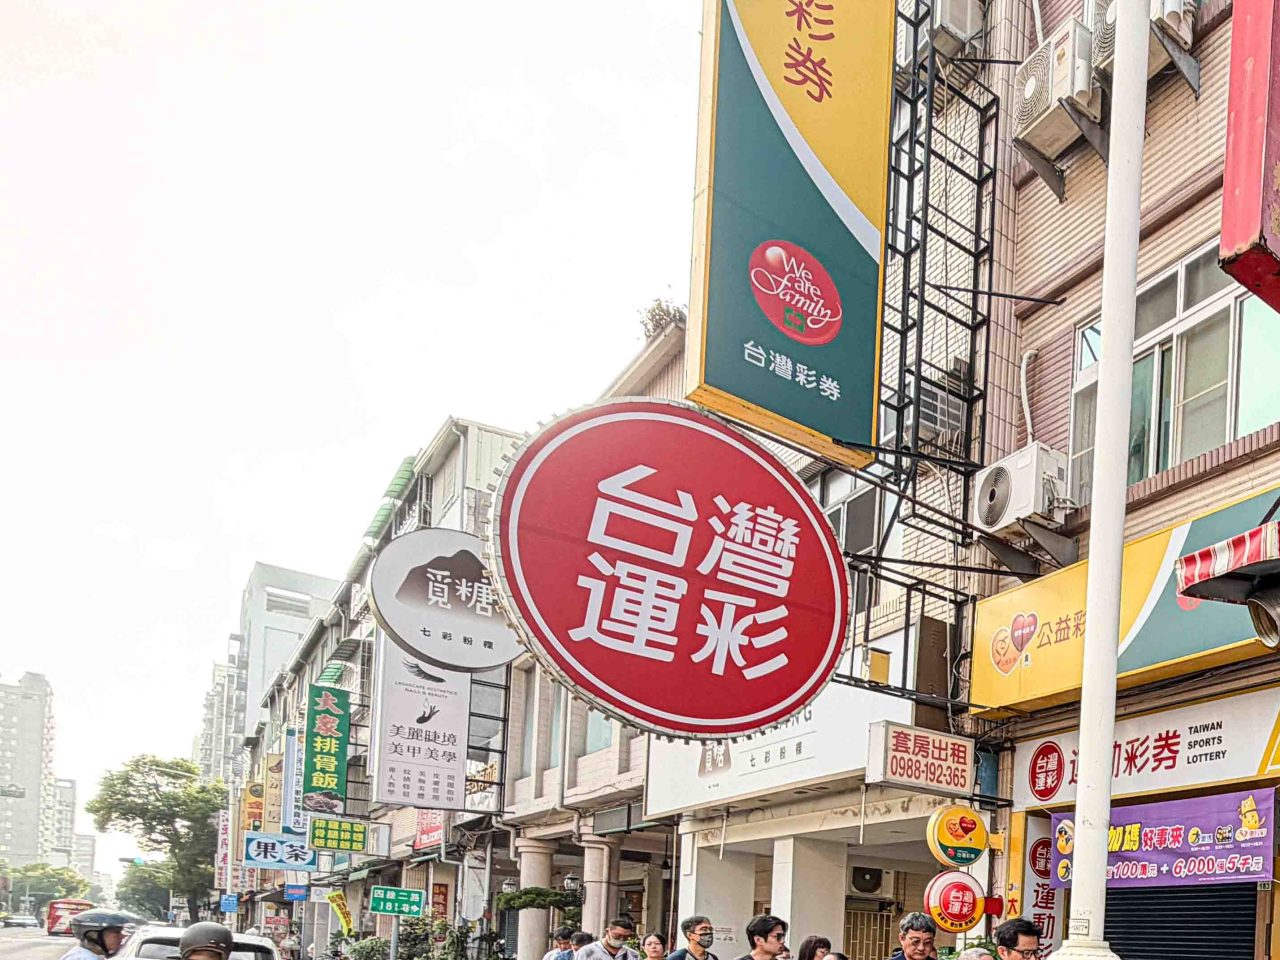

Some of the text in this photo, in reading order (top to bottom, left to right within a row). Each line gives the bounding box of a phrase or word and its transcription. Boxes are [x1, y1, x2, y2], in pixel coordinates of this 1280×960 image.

[766, 247, 812, 281] We
[795, 277, 821, 299] are
[743, 340, 841, 401] 台灣彩券
[597, 465, 801, 598] 台灣
[569, 552, 792, 680] 運彩
[1188, 721, 1223, 736] TAIWAN
[1188, 736, 1223, 750] SPORTS
[891, 729, 968, 768] 套房出租
[1187, 750, 1227, 765] LOTTERY
[890, 757, 967, 789] 0988-192-365
[254, 841, 309, 862] 果茶
